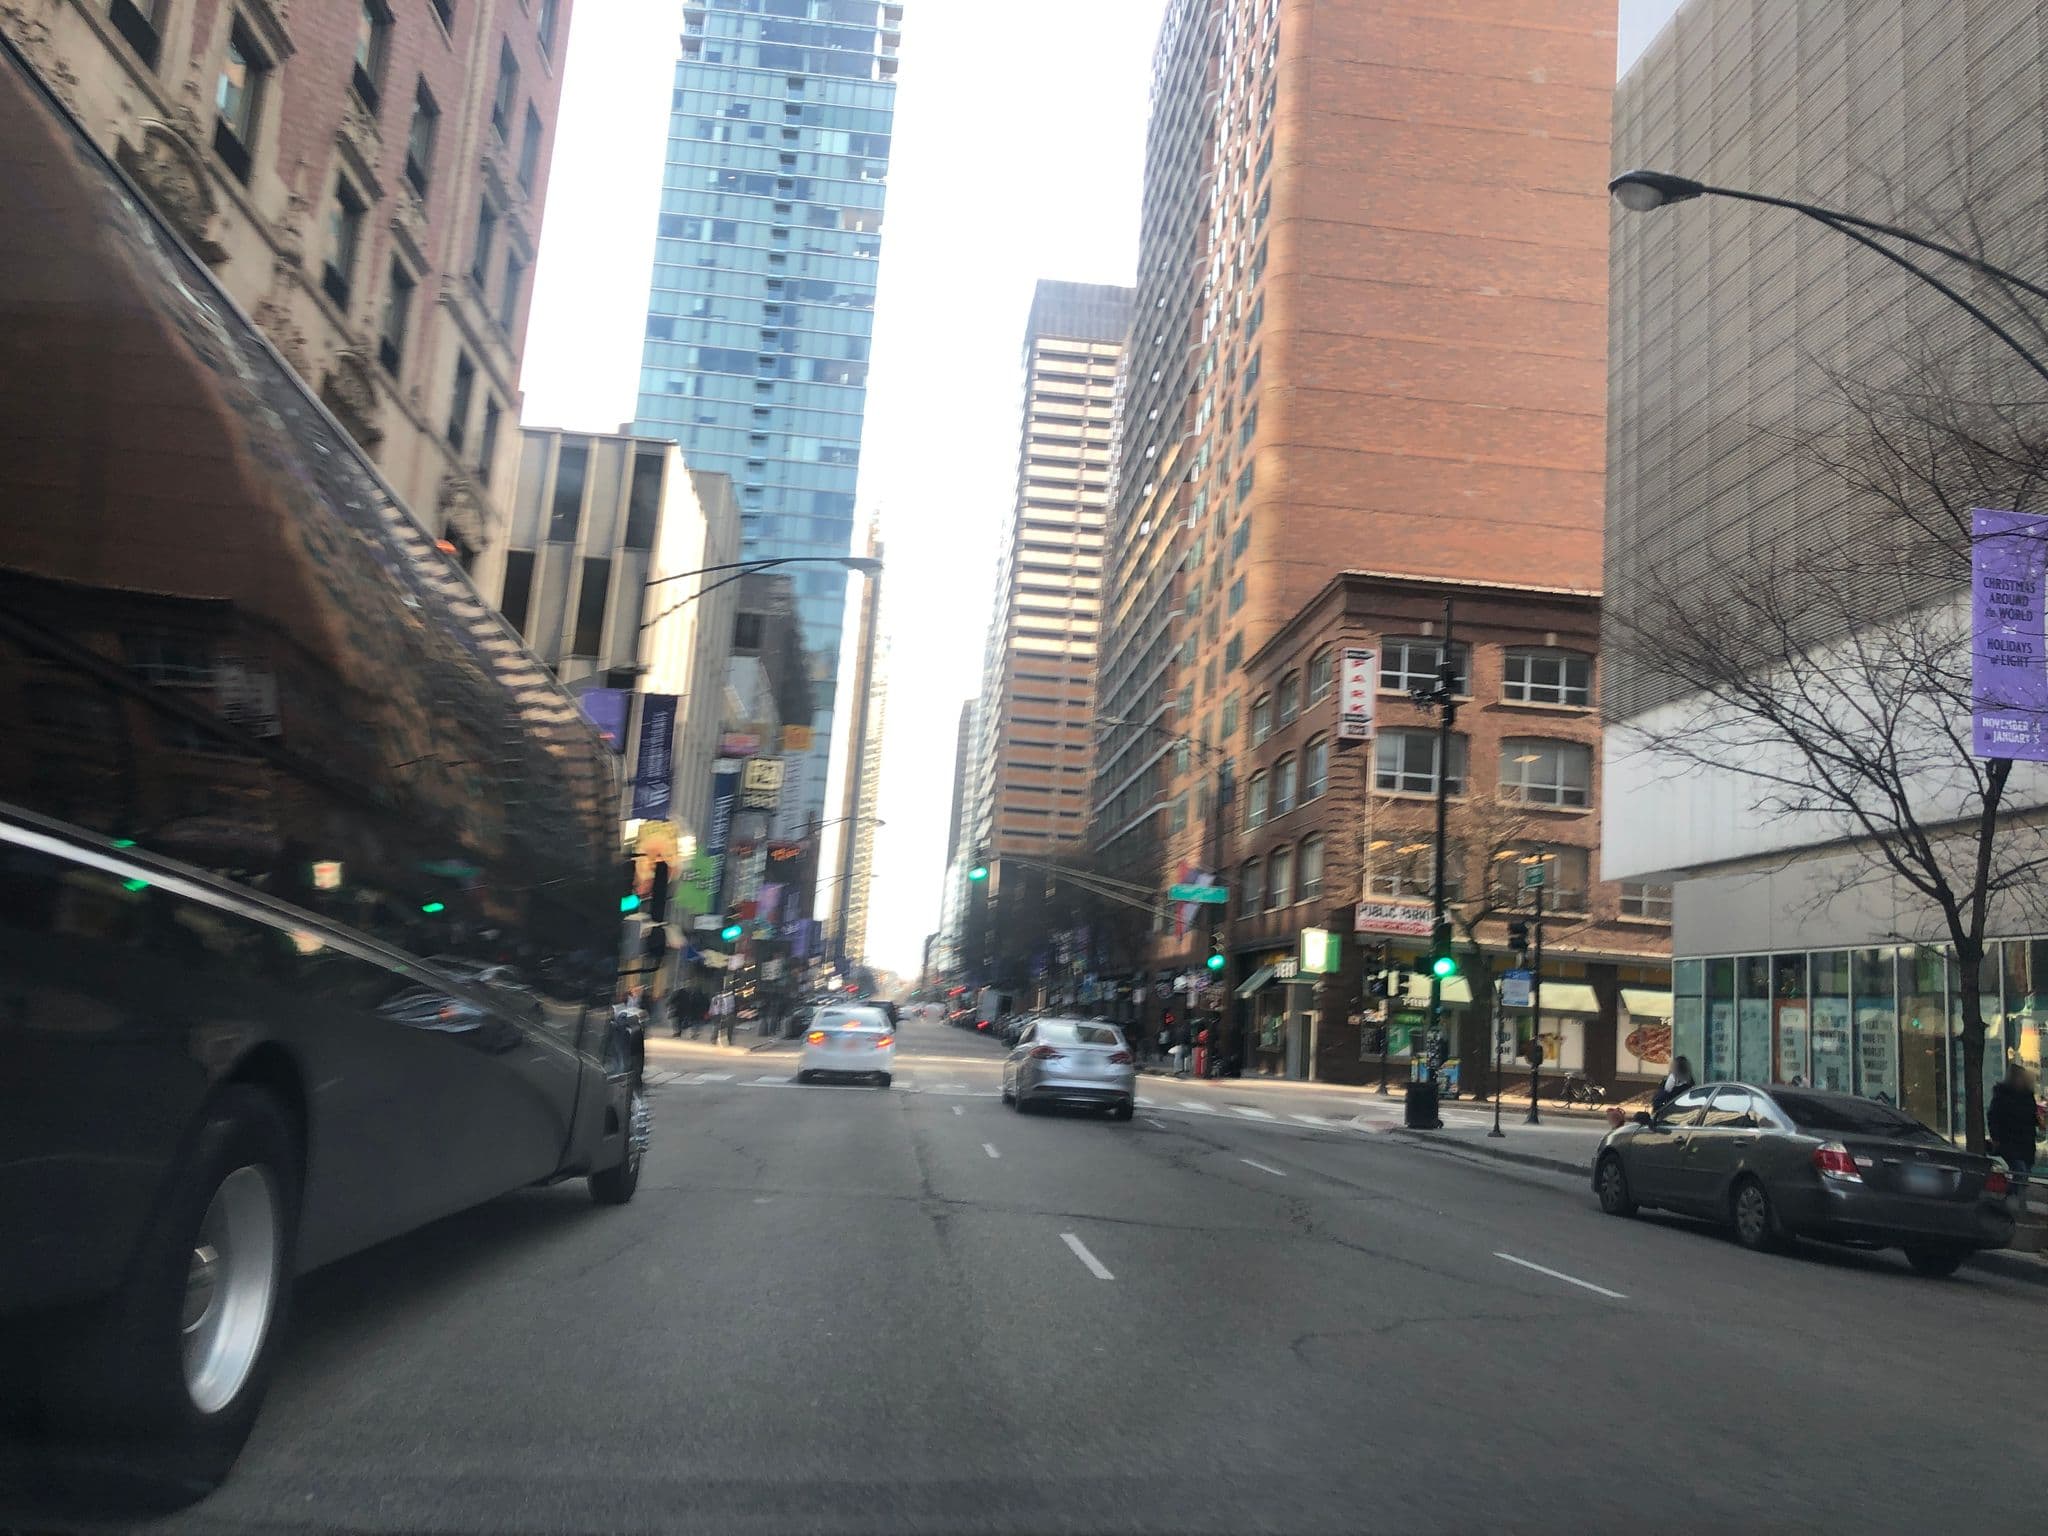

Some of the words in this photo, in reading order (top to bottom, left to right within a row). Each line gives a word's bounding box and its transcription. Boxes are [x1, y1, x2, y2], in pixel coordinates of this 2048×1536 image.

[1983, 576, 2035, 594] CHRISTMAS
[1989, 592, 2029, 607] AROUND
[1999, 607, 2033, 622] WORLD
[1987, 637, 2033, 654] HOLIDAYS
[2000, 654, 2029, 668] LIGHT
[1982, 717, 2029, 731] NOVEMBER
[1992, 730, 2030, 744] JANUARY
[1360, 904, 1396, 919] PUBLIC
